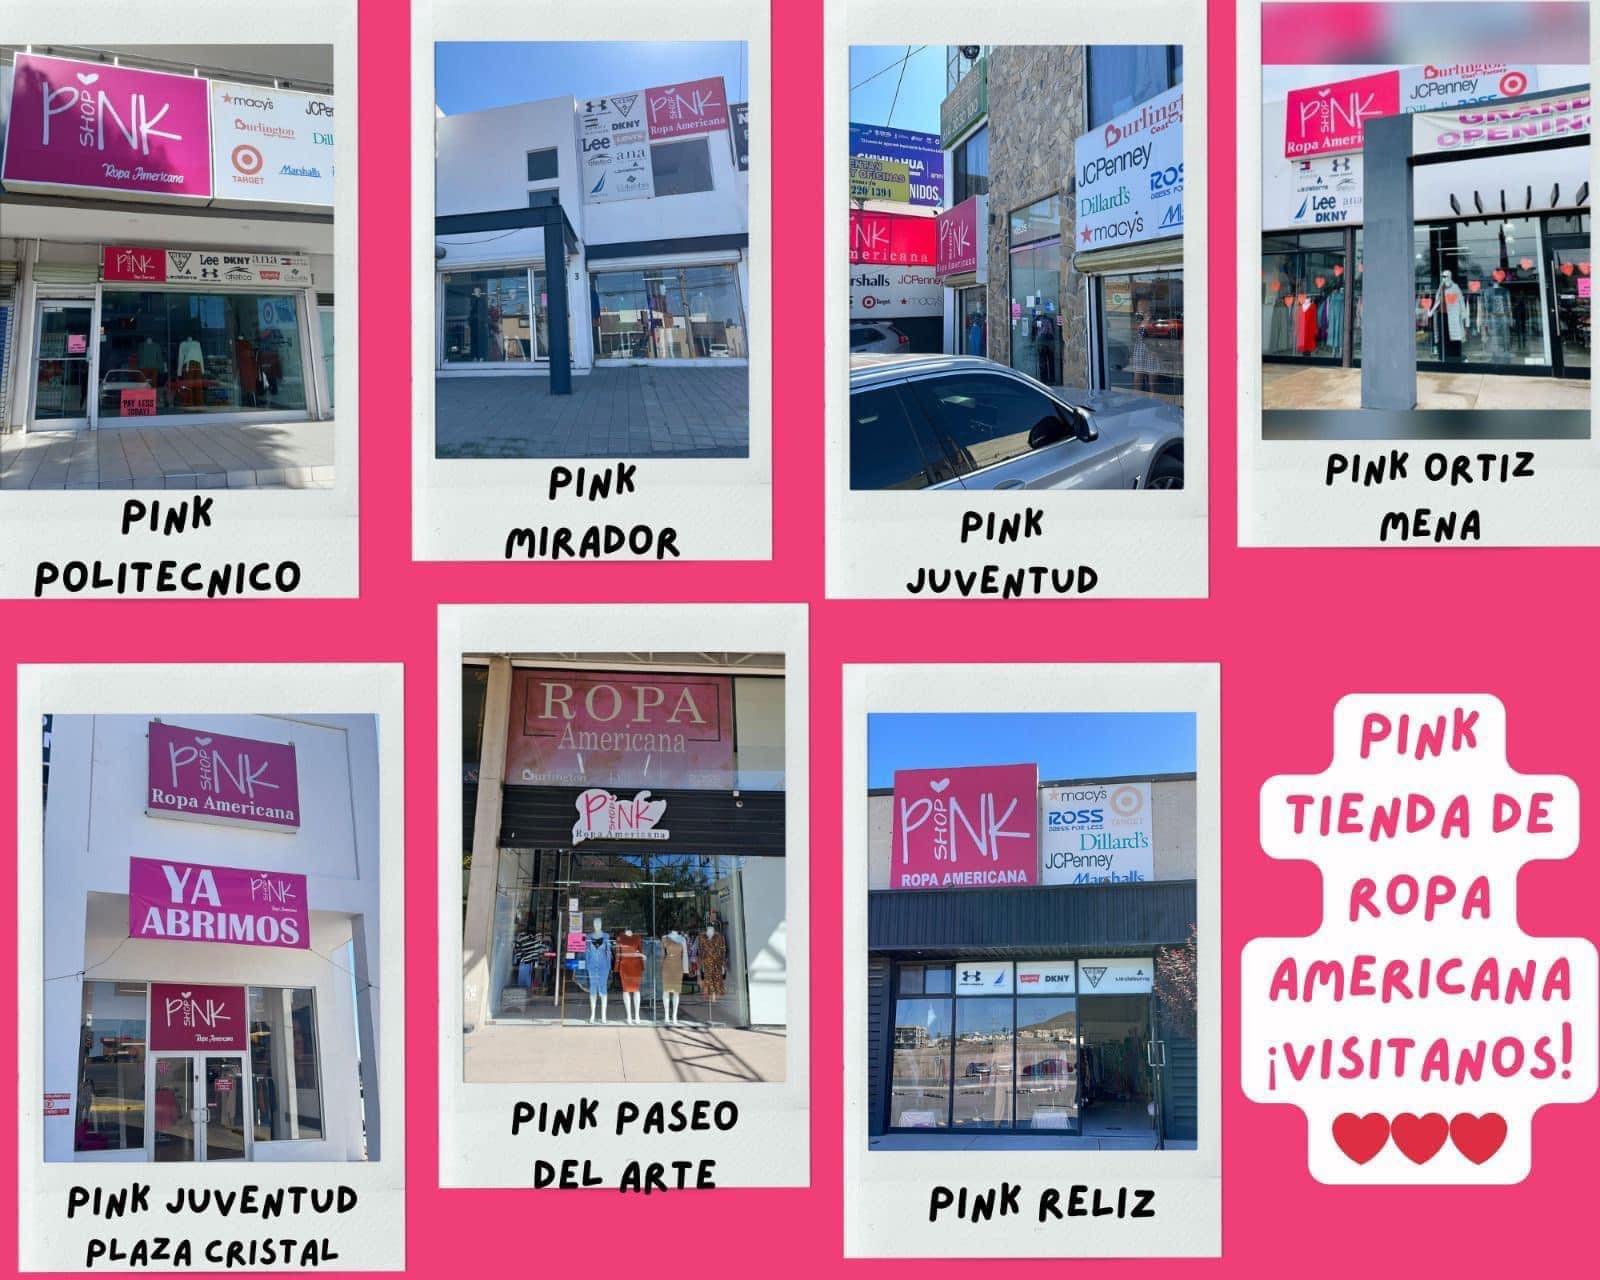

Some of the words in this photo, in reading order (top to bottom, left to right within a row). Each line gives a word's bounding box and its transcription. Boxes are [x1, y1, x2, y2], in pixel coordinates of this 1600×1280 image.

[1410, 79, 1479, 101] JCPenney
[233, 97, 274, 112] macy's
[79, 89, 97, 148] SHOP
[234, 117, 296, 137] Burlington
[611, 120, 641, 131] DKNY
[650, 124, 674, 135] Ropa
[676, 117, 726, 130] Americana
[1319, 101, 1331, 133] SHOP
[1436, 113, 1591, 148] OPENIN
[582, 137, 611, 152] Lee
[1286, 139, 1320, 155] Ropa
[1322, 131, 1364, 149] Ameri
[102, 163, 131, 181] Ropa
[133, 166, 185, 184] Americana
[1078, 142, 1152, 189] JCPenney
[231, 175, 264, 185] TARGET
[1080, 185, 1131, 218] Dillard's
[1312, 195, 1337, 211] Lee
[1094, 210, 1144, 240] macy's
[1315, 210, 1348, 223] DKNY
[199, 254, 220, 266] Lee
[223, 256, 250, 265] DKNY
[537, 682, 707, 725] ROPA
[557, 722, 687, 753] Americana
[198, 750, 213, 791] SHOP
[151, 788, 198, 809] Ropa
[203, 796, 295, 821] Americana
[1061, 786, 1108, 805] macy's
[1048, 808, 1105, 826] ROSS
[575, 828, 602, 840] Ropa
[605, 829, 666, 839] Americana
[933, 798, 949, 861] SHOP
[1079, 832, 1150, 852] Dillard's
[1045, 851, 1114, 870] JCPenney
[161, 864, 222, 907] YA
[900, 872, 939, 888] ROPA
[942, 868, 1028, 886] AMERICANA
[140, 906, 301, 946] ABRIMOS
[1045, 975, 1070, 983] DKNY
[183, 1000, 192, 1026] SHOP
